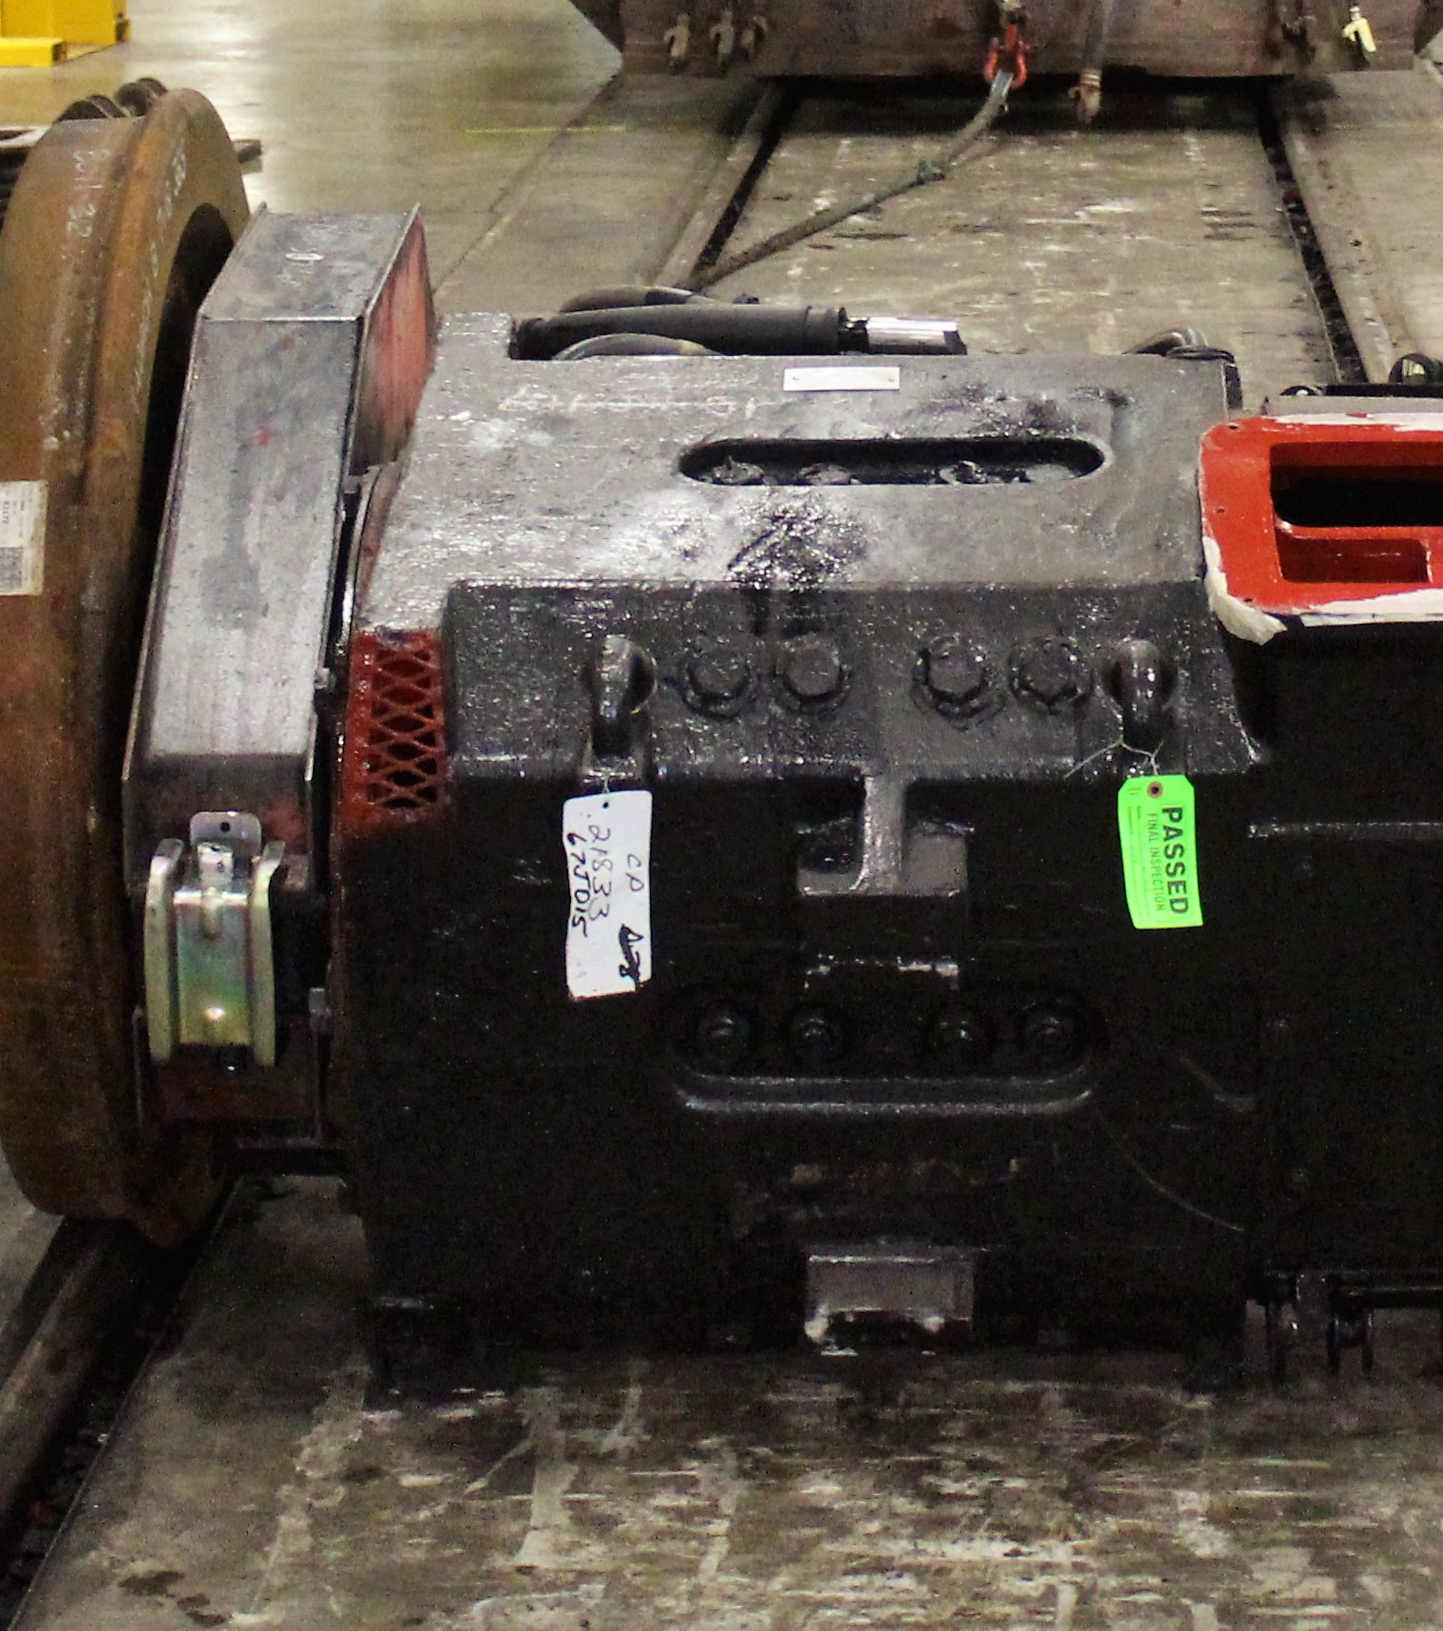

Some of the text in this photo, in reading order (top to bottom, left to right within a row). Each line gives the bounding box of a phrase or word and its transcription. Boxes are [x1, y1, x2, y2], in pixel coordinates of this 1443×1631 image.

[1146, 813, 1167, 911] FINAL INSPECTION
[1161, 807, 1190, 915] PASSED
